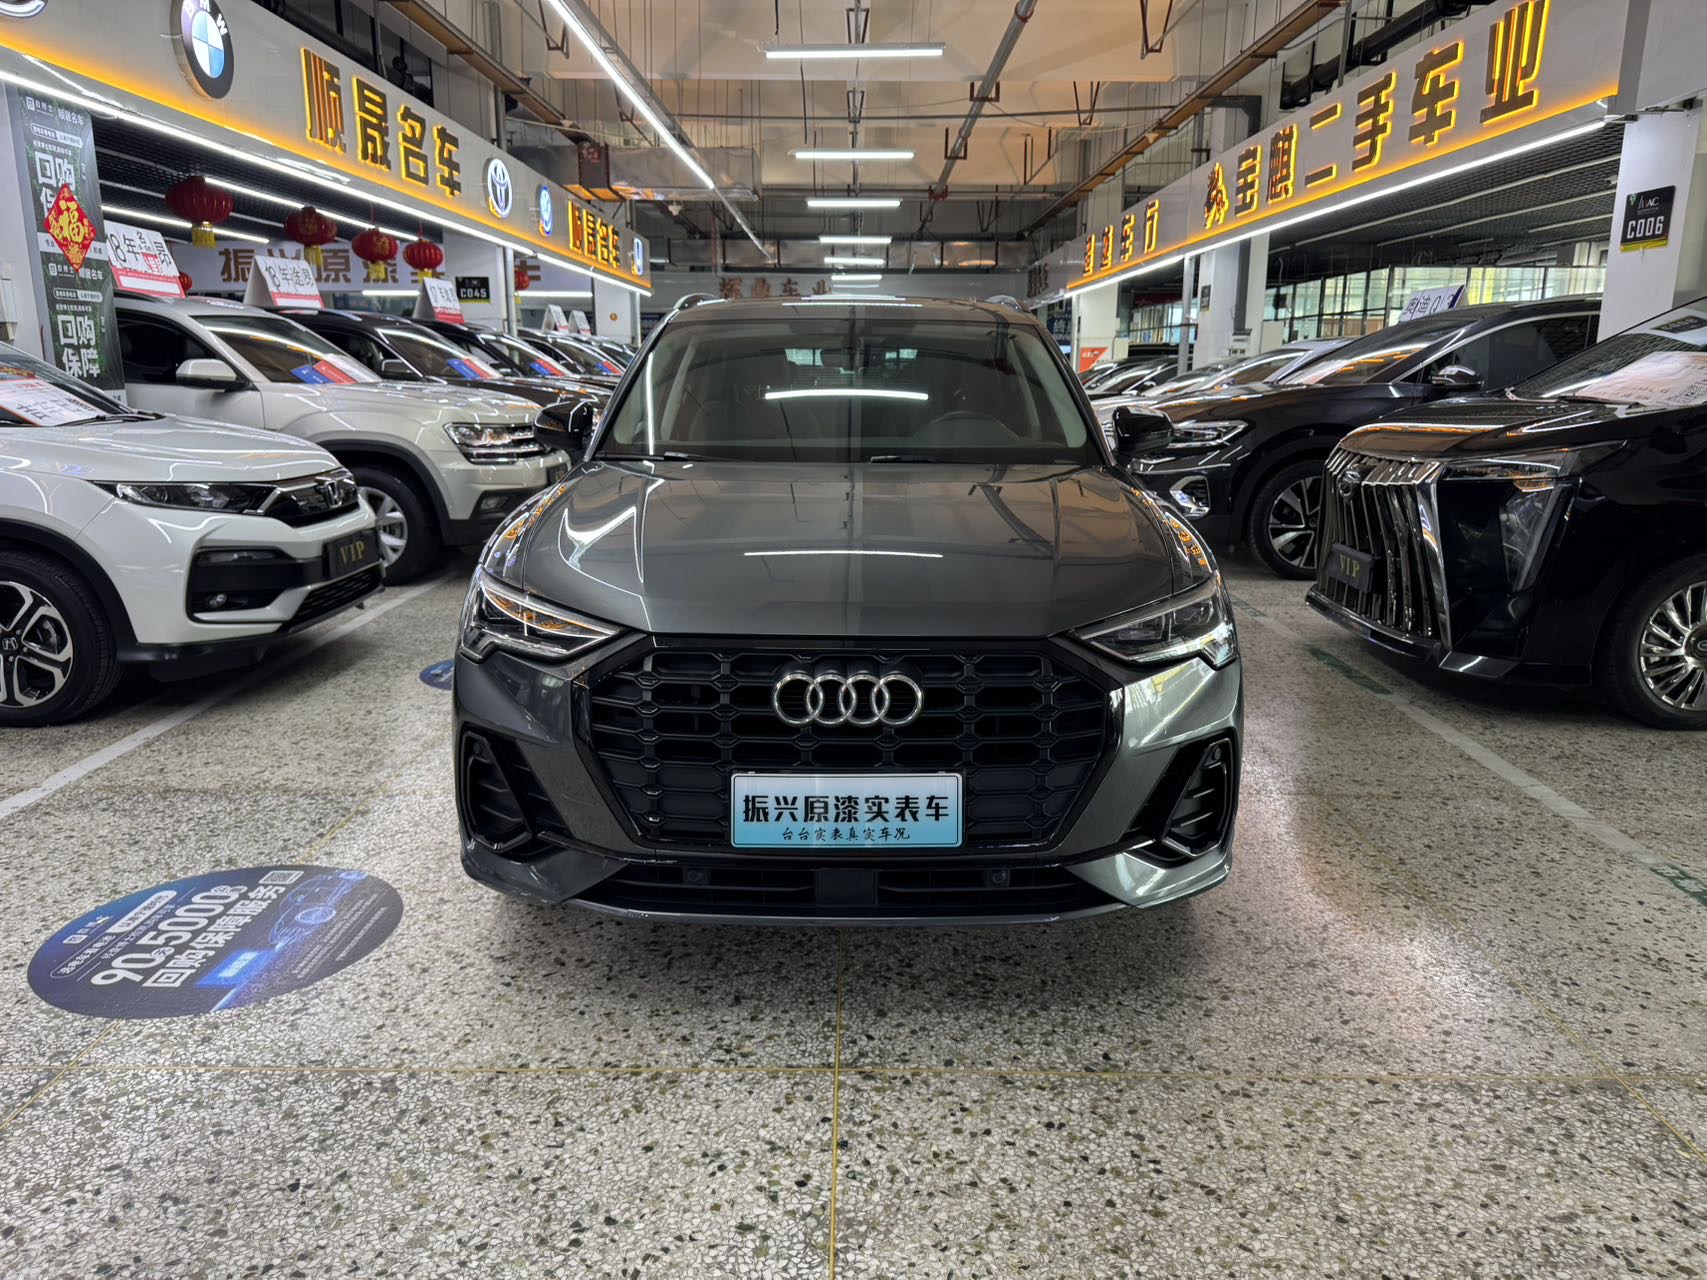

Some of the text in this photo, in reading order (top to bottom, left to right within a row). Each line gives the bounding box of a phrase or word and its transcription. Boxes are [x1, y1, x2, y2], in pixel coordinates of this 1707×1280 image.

[300, 47, 462, 198] 顺晟名车
[34, 151, 76, 191] 回购
[58, 199, 85, 243] 福
[1627, 216, 1664, 239] C006
[460, 288, 487, 298] C045
[57, 315, 96, 346] 回购
[62, 347, 101, 378] 保障
[340, 541, 365, 564] VIP
[1339, 553, 1361, 577] VIP
[743, 794, 949, 823] 振兴原漆实表车
[781, 827, 910, 842] 台台实表真实车况
[142, 885, 286, 987] 回购保障服务
